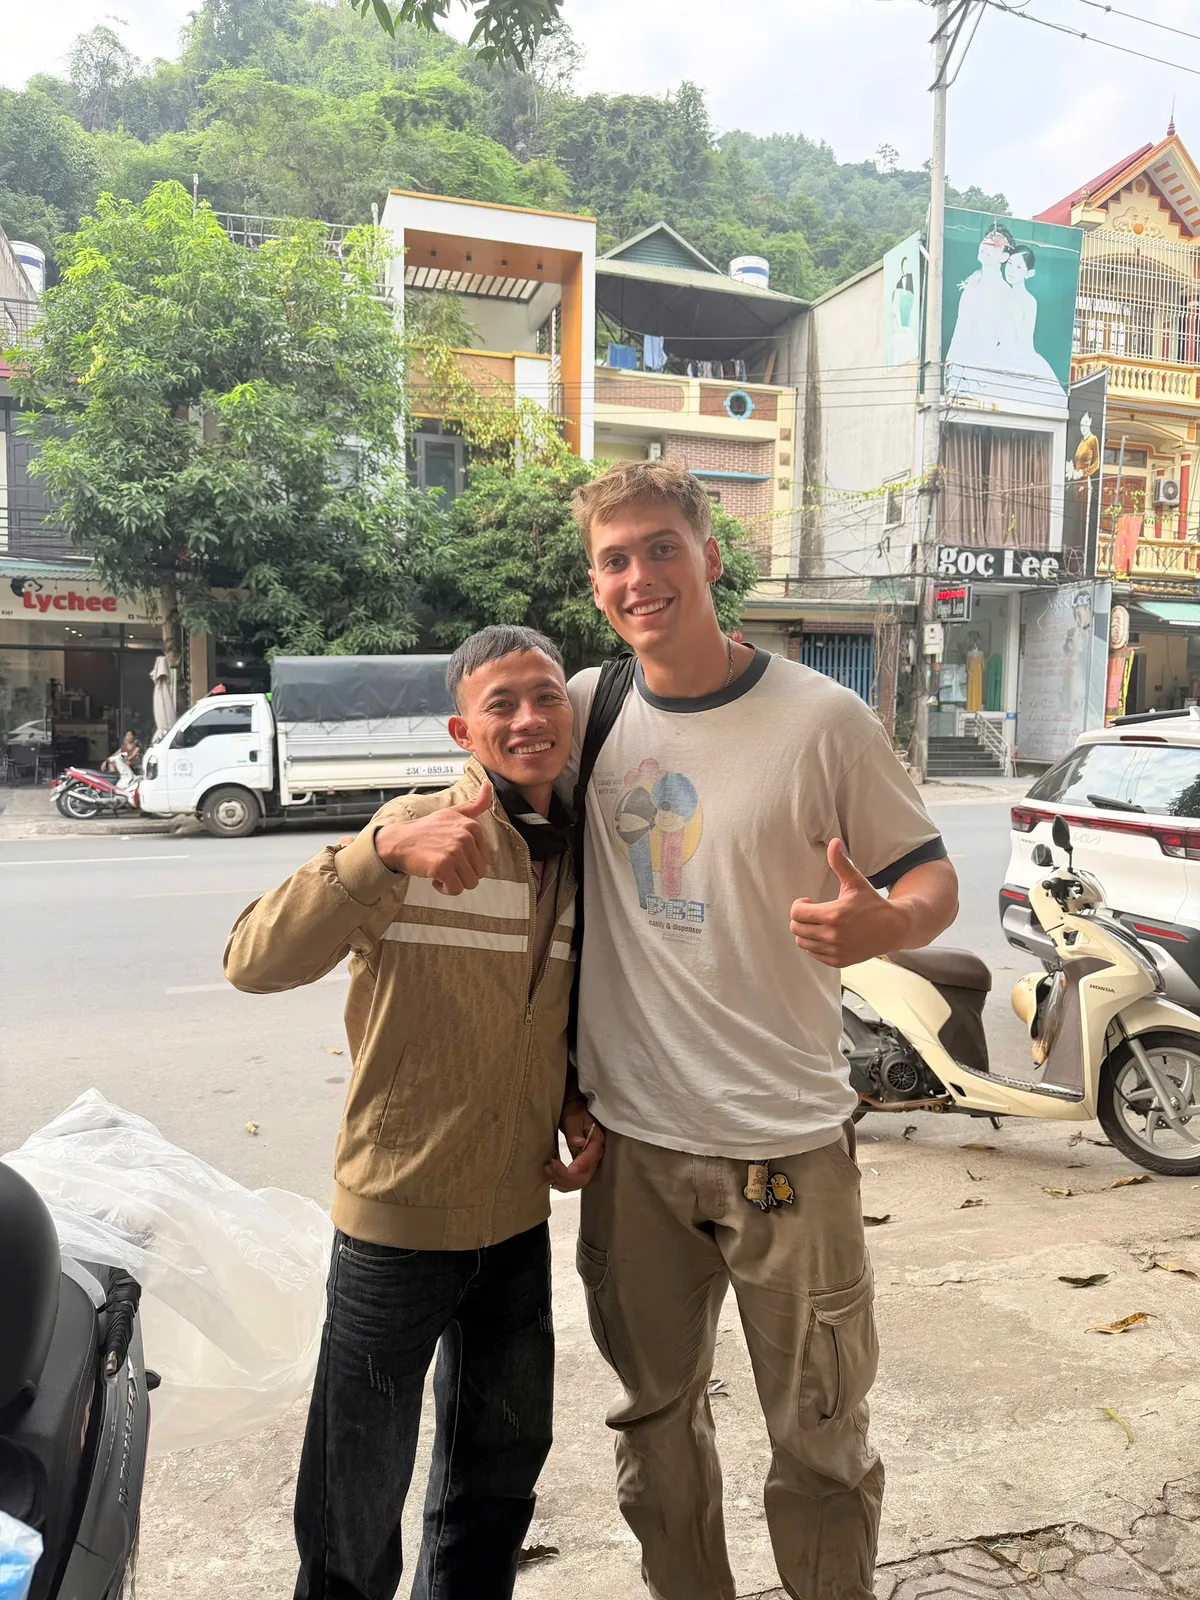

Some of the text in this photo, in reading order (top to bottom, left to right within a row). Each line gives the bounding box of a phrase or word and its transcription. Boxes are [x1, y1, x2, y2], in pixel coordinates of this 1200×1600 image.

[1003, 550, 1059, 578] Lee
[23, 591, 117, 612] Lychee
[648, 919, 703, 935] candy & dispenser
[1089, 983, 1116, 994] HONDA
